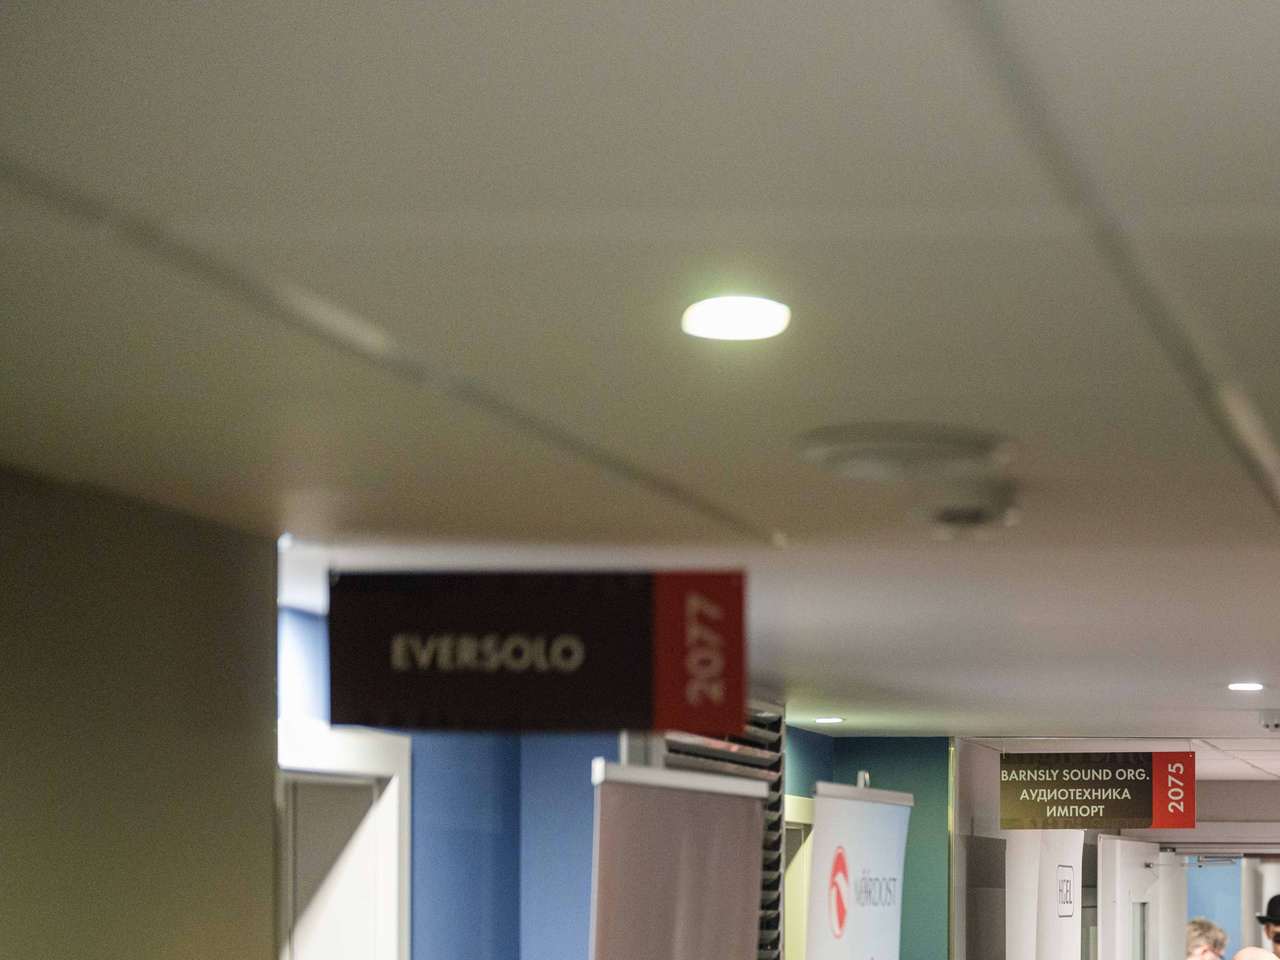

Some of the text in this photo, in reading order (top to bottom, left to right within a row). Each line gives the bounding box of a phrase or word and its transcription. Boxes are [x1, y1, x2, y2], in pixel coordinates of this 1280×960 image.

[390, 632, 586, 672] EVERSOLO
[684, 592, 724, 706] 2077
[1001, 768, 1150, 781] BARNSLY SOUND ORG.
[1168, 763, 1184, 813] 2075
[1020, 788, 1132, 802] АУДИОТЕХНИКА
[1046, 805, 1105, 817] ИМПОРТ
